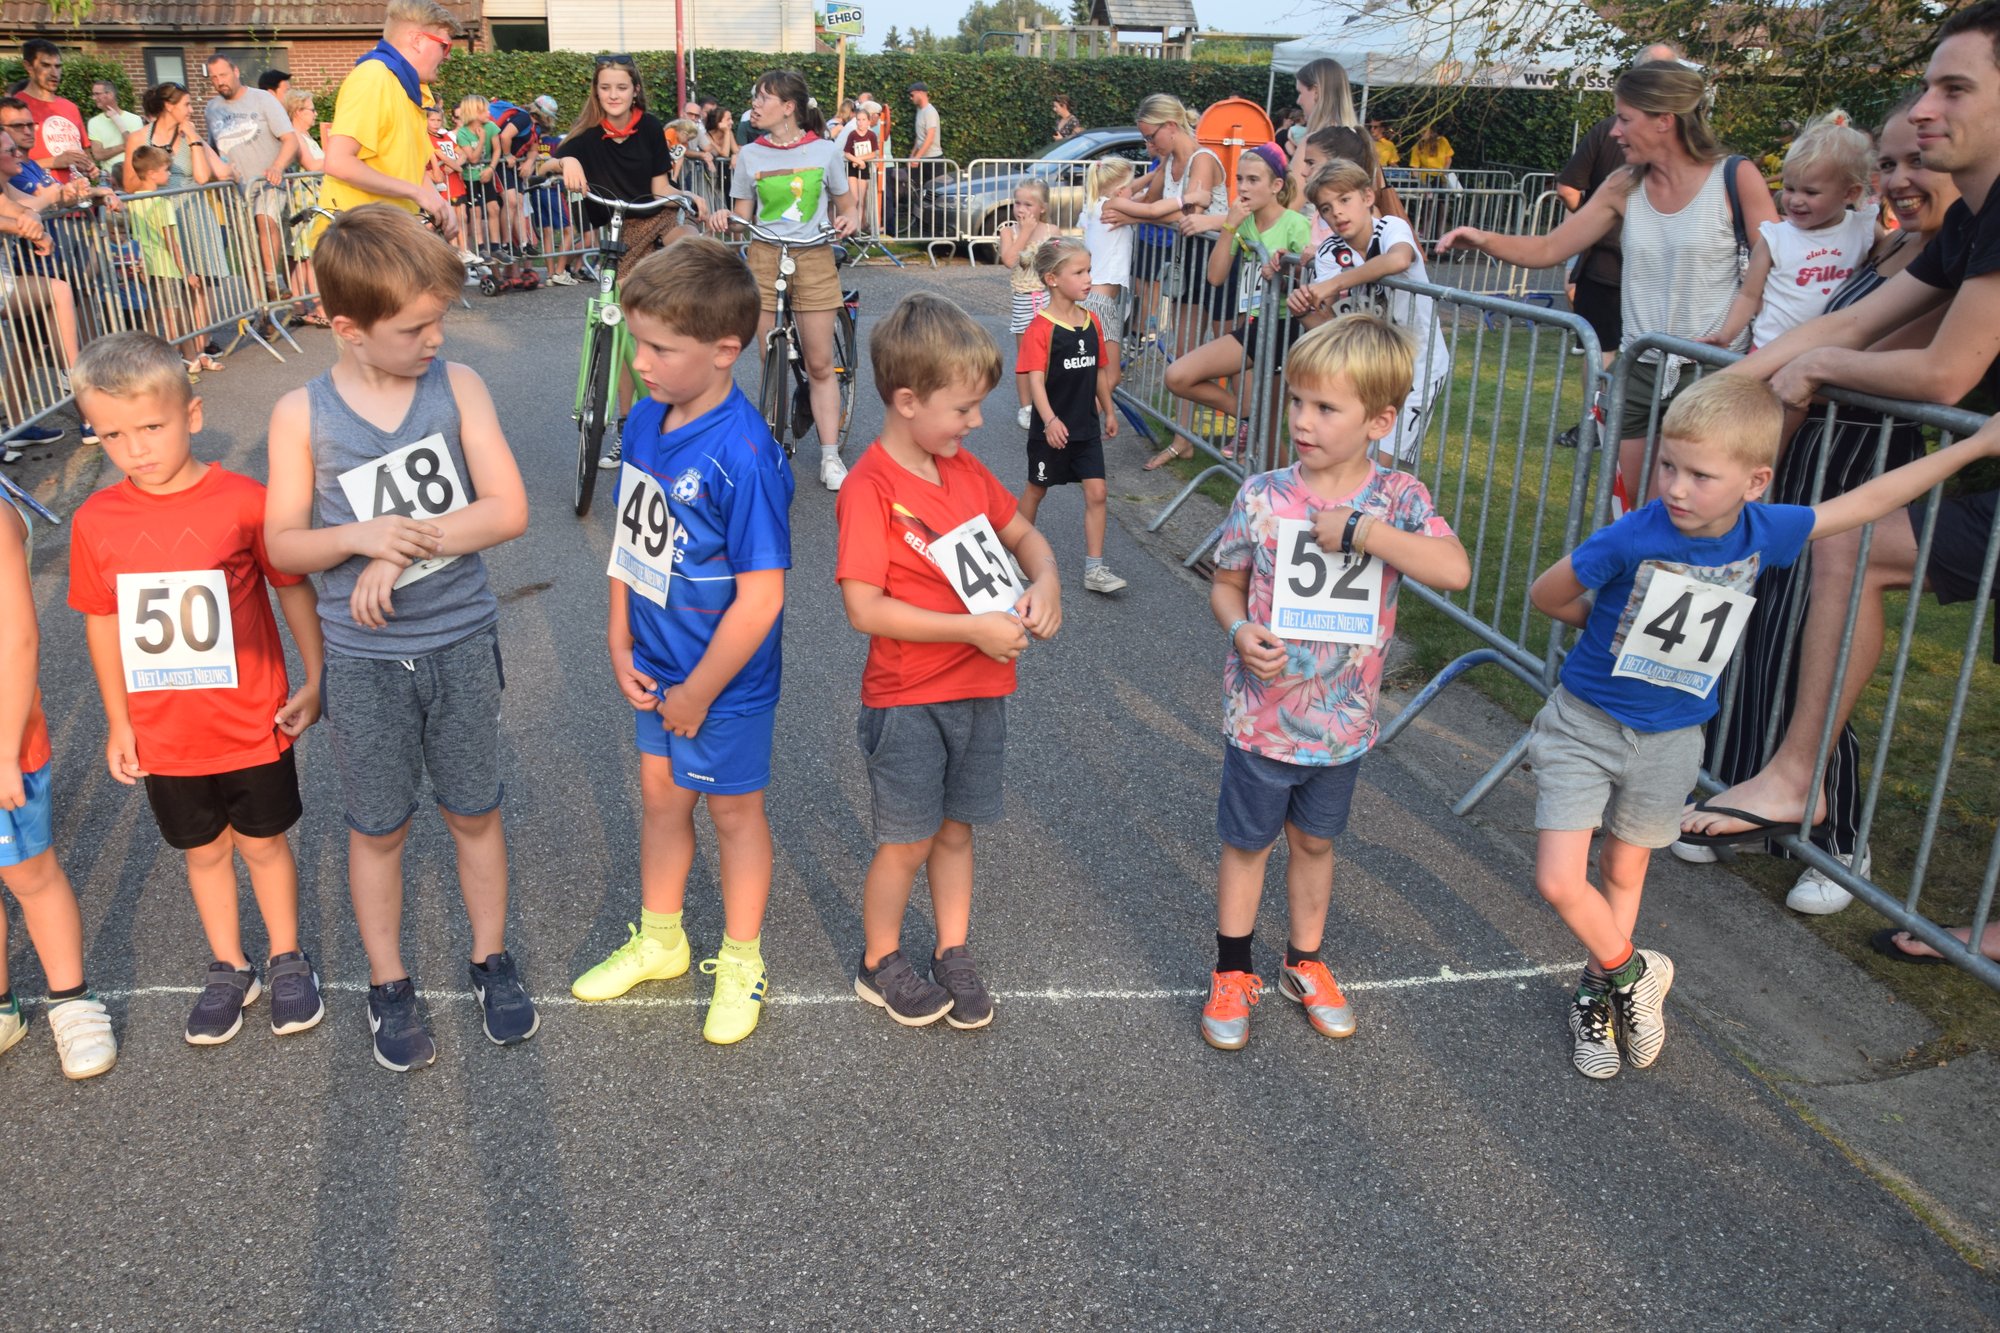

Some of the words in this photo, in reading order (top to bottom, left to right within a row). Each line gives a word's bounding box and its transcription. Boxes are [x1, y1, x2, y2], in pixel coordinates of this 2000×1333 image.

[828, 11, 862, 25] EHBO
[1461, 77, 1494, 85] essen
[1806, 248, 1828, 260] club
[1831, 248, 1842, 257] de
[1408, 407, 1421, 432] 7
[373, 447, 453, 519] 48
[622, 480, 668, 557] 49
[955, 530, 1013, 599] 45
[1288, 530, 1372, 601] 52
[135, 584, 220, 654] 50
[1282, 609, 1300, 627] HET
[1301, 611, 1337, 630] LAATSTE
[1337, 613, 1369, 633] NIEUWS
[1643, 591, 1733, 663] 41
[136, 670, 156, 687] HET
[155, 669, 193, 686] LAATSTE
[192, 667, 229, 684] NIEUWS
[1623, 656, 1642, 671] HET
[1640, 659, 1677, 682] LAATSTE
[1675, 669, 1707, 689] NIEUWS
